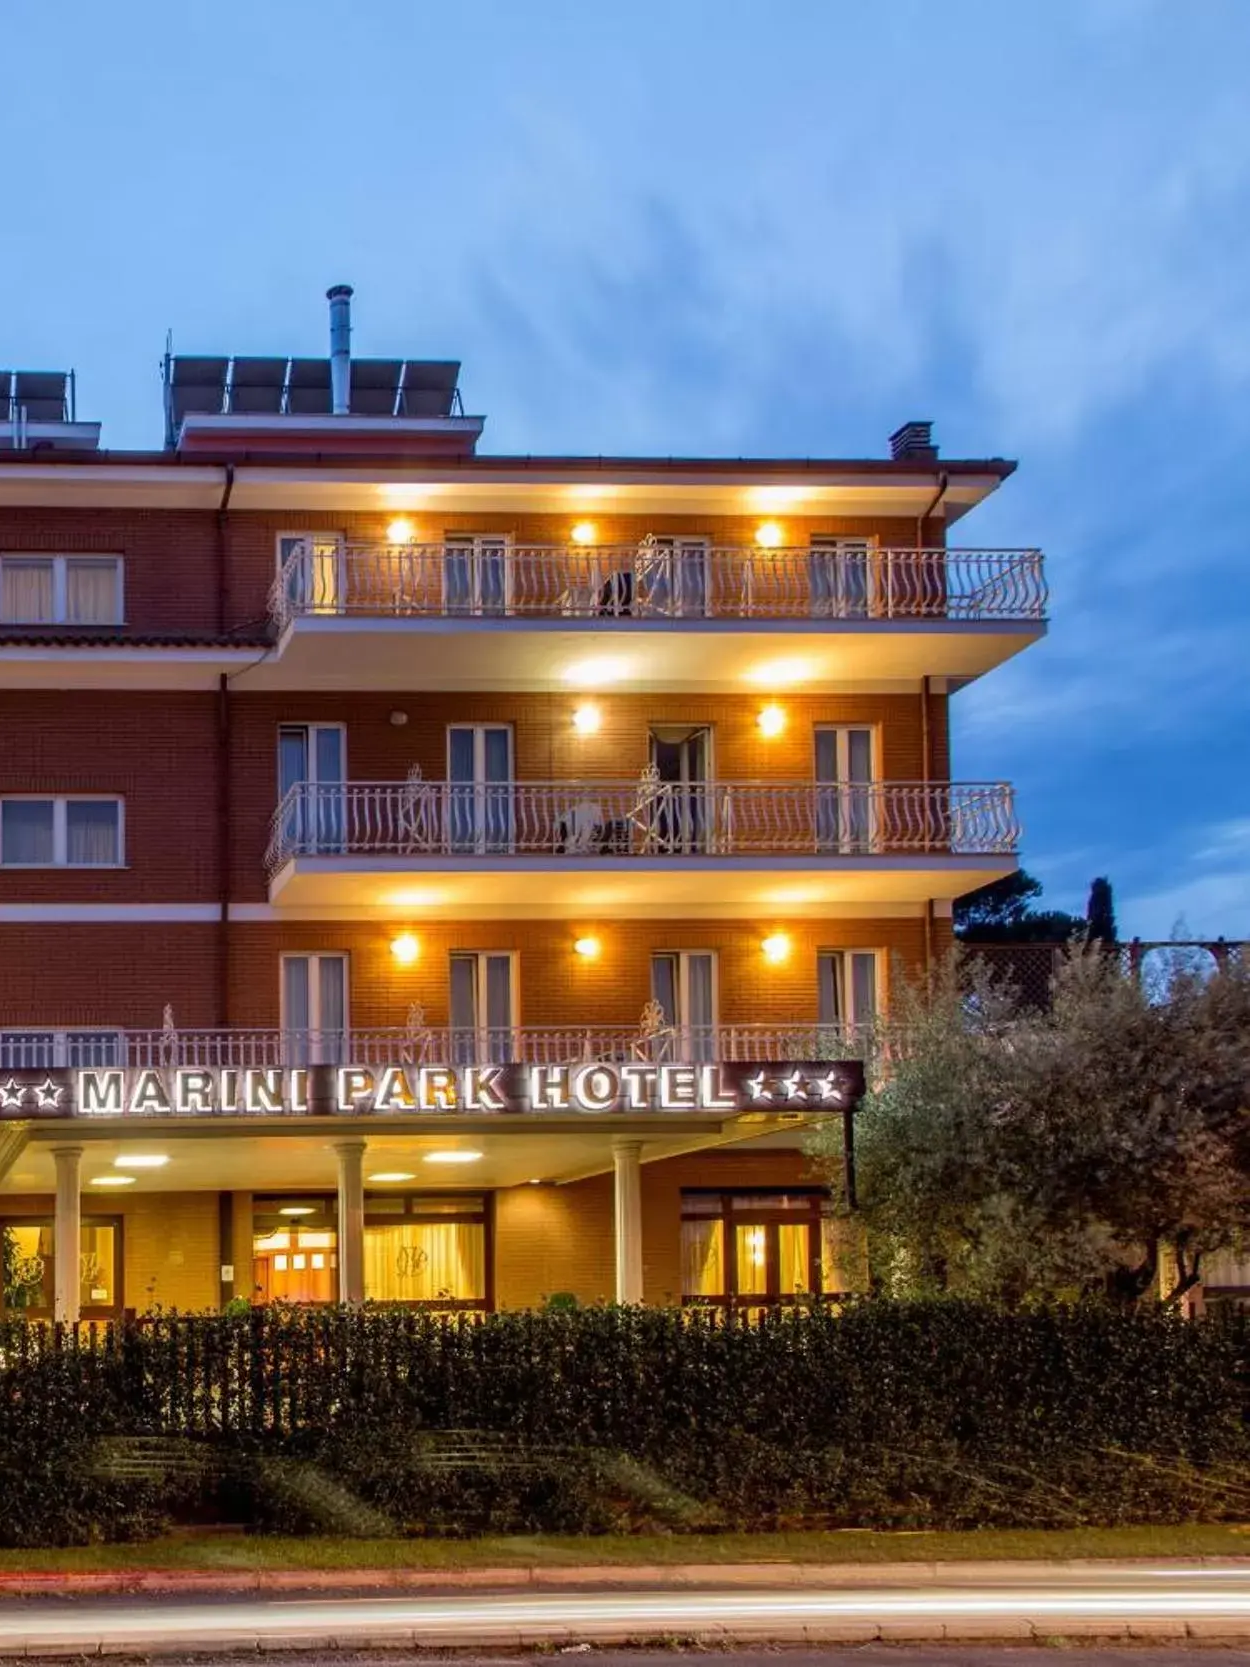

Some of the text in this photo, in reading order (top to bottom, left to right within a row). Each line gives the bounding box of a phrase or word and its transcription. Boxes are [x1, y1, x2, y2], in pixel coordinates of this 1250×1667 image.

[78, 1065, 736, 1113] MARINI PARK HOTEL
